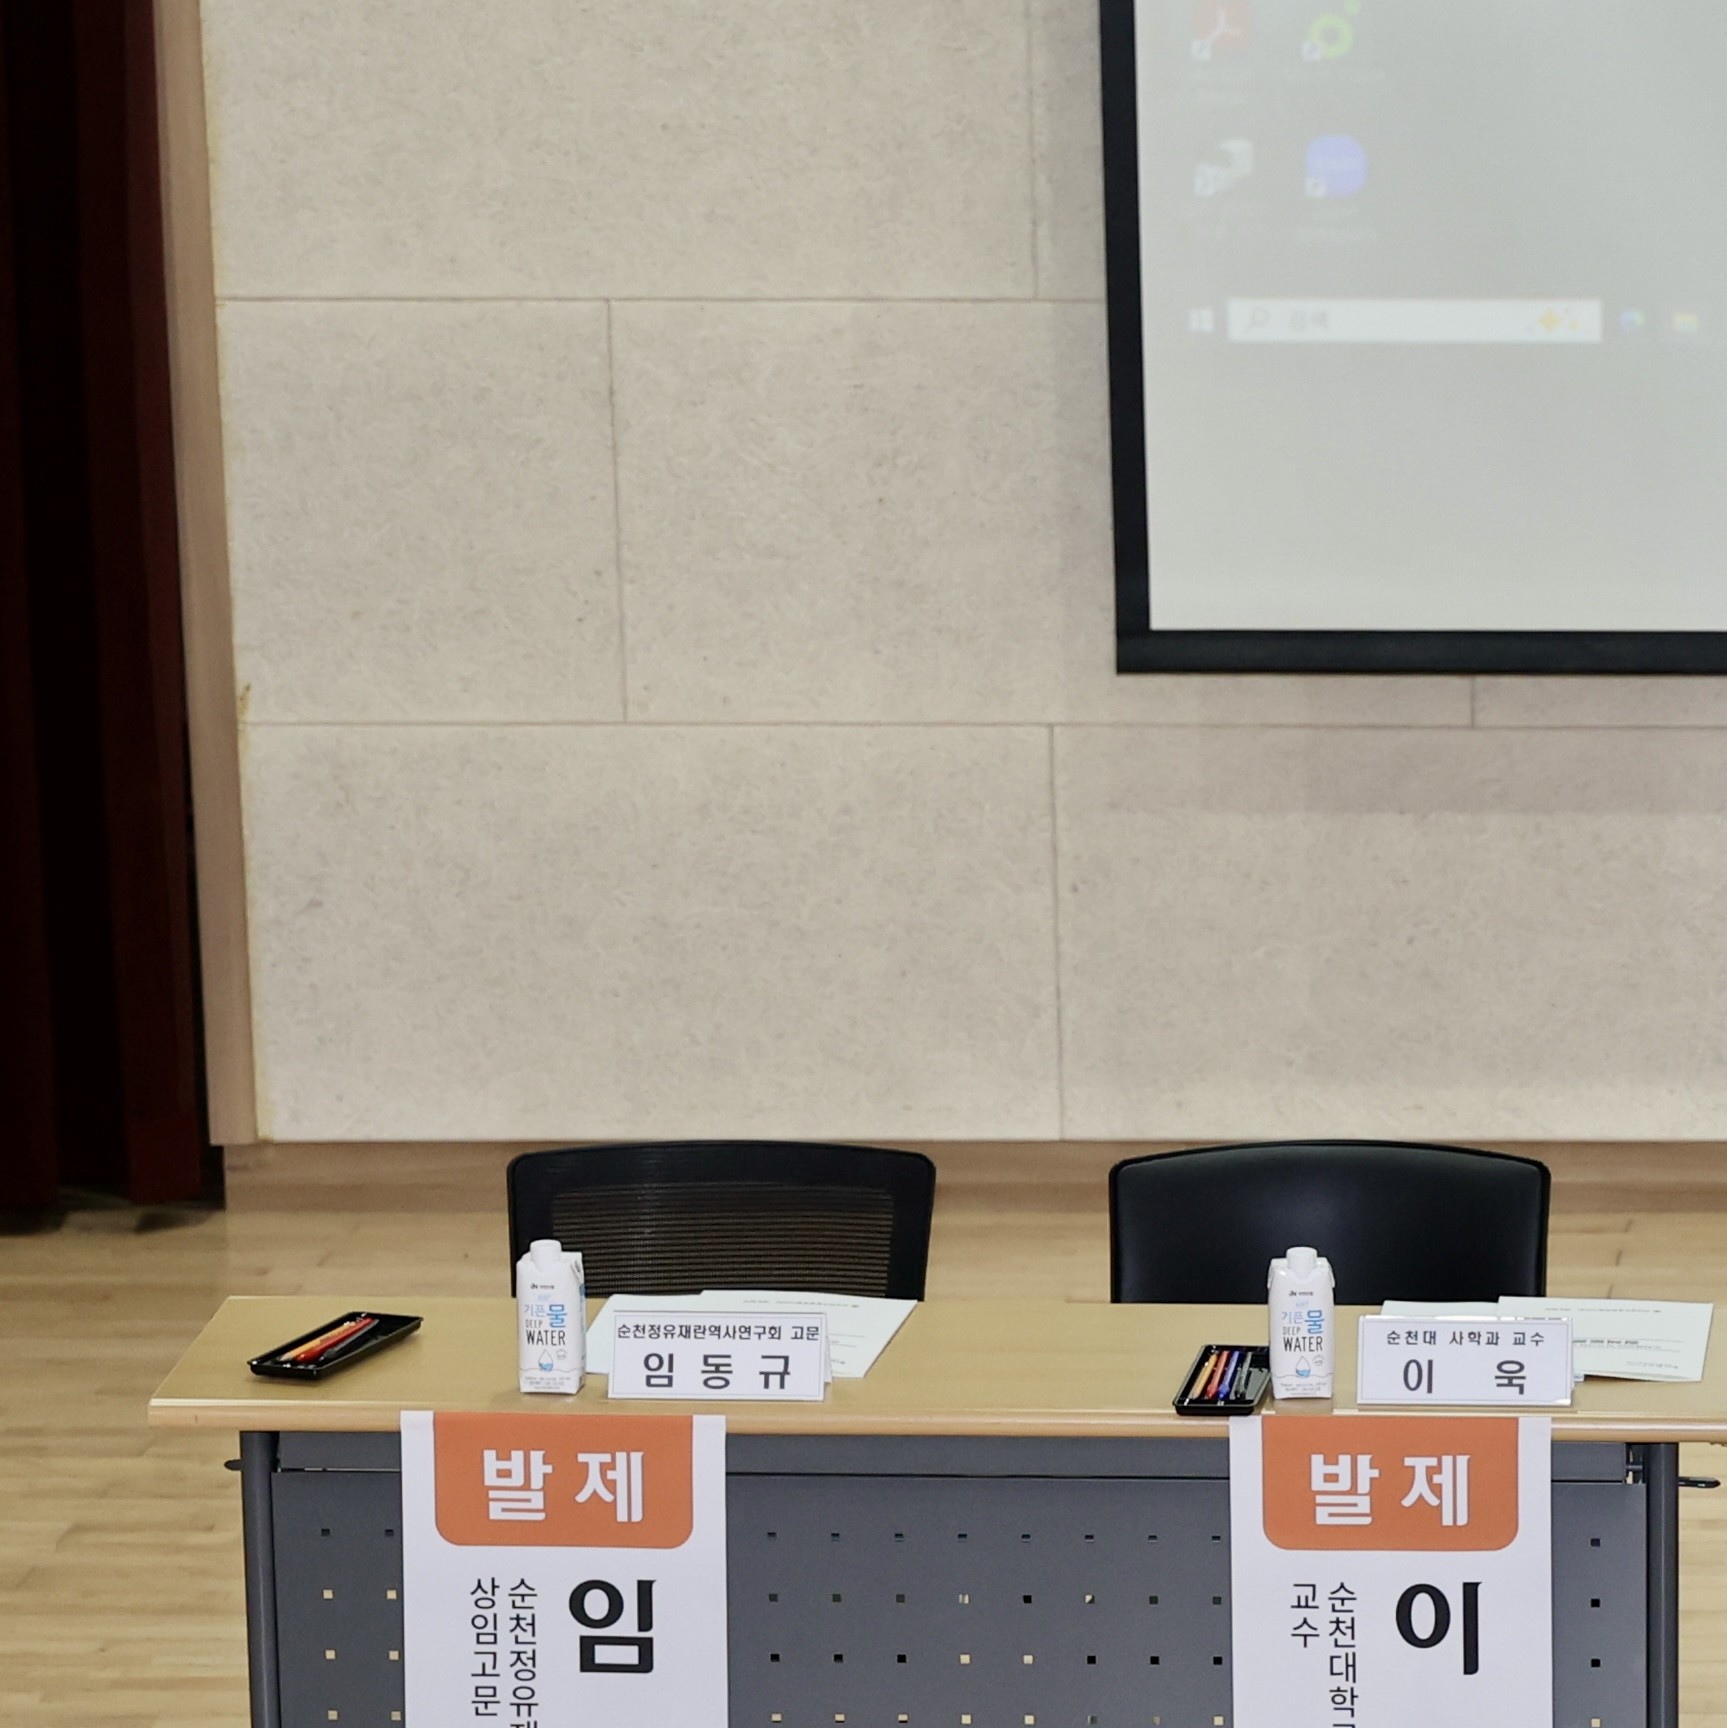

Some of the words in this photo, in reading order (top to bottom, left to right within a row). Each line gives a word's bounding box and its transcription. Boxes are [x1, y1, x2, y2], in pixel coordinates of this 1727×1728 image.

[525, 1318, 544, 1329] DEEP
[1282, 1326, 1301, 1334] DEEP
[525, 1330, 567, 1346] WATER
[617, 1324, 782, 1341] 순천정유재란역사연구회
[790, 1325, 819, 1341] 고문
[1387, 1330, 1437, 1346] 순천대
[1449, 1331, 1500, 1346] 사학과
[1512, 1331, 1544, 1347] 교수
[1283, 1336, 1323, 1352] WATER
[1290, 1583, 1320, 1648] 교수
[470, 1577, 501, 1717] 상임고문
